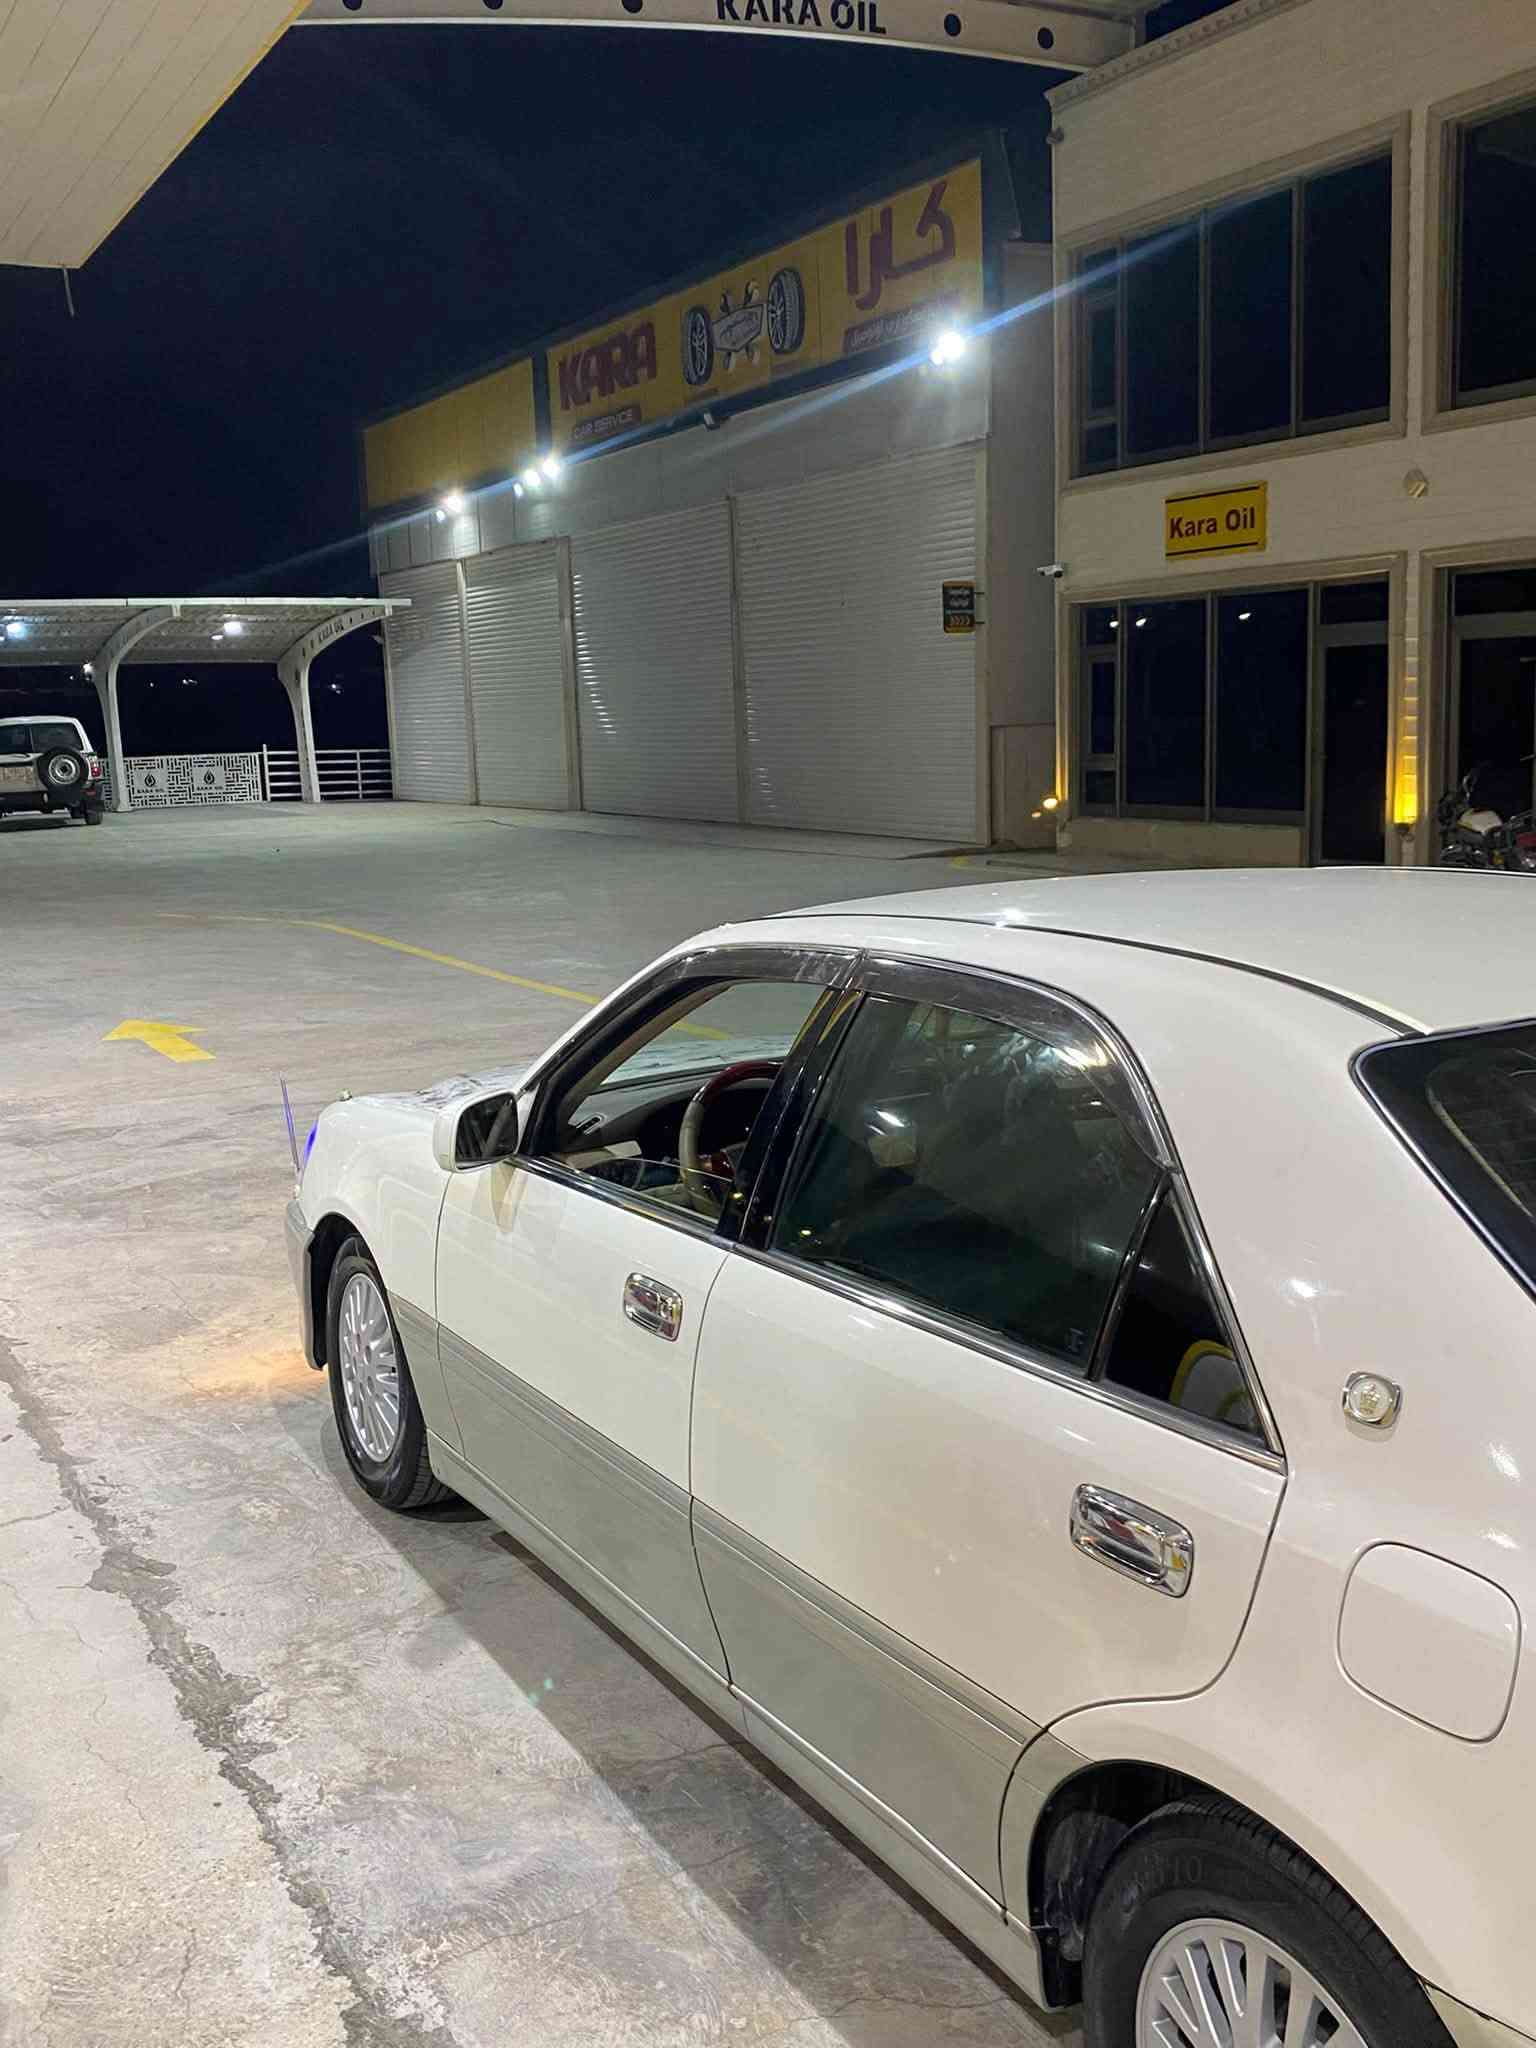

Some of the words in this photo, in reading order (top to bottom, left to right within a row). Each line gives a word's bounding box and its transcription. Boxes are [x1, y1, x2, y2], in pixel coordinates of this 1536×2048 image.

[716, 0, 822, 27] KARA
[831, 0, 887, 34] OIL
[559, 320, 656, 411] KARA
[1169, 516, 1217, 539] Kara
[1225, 506, 1255, 531] Oil
